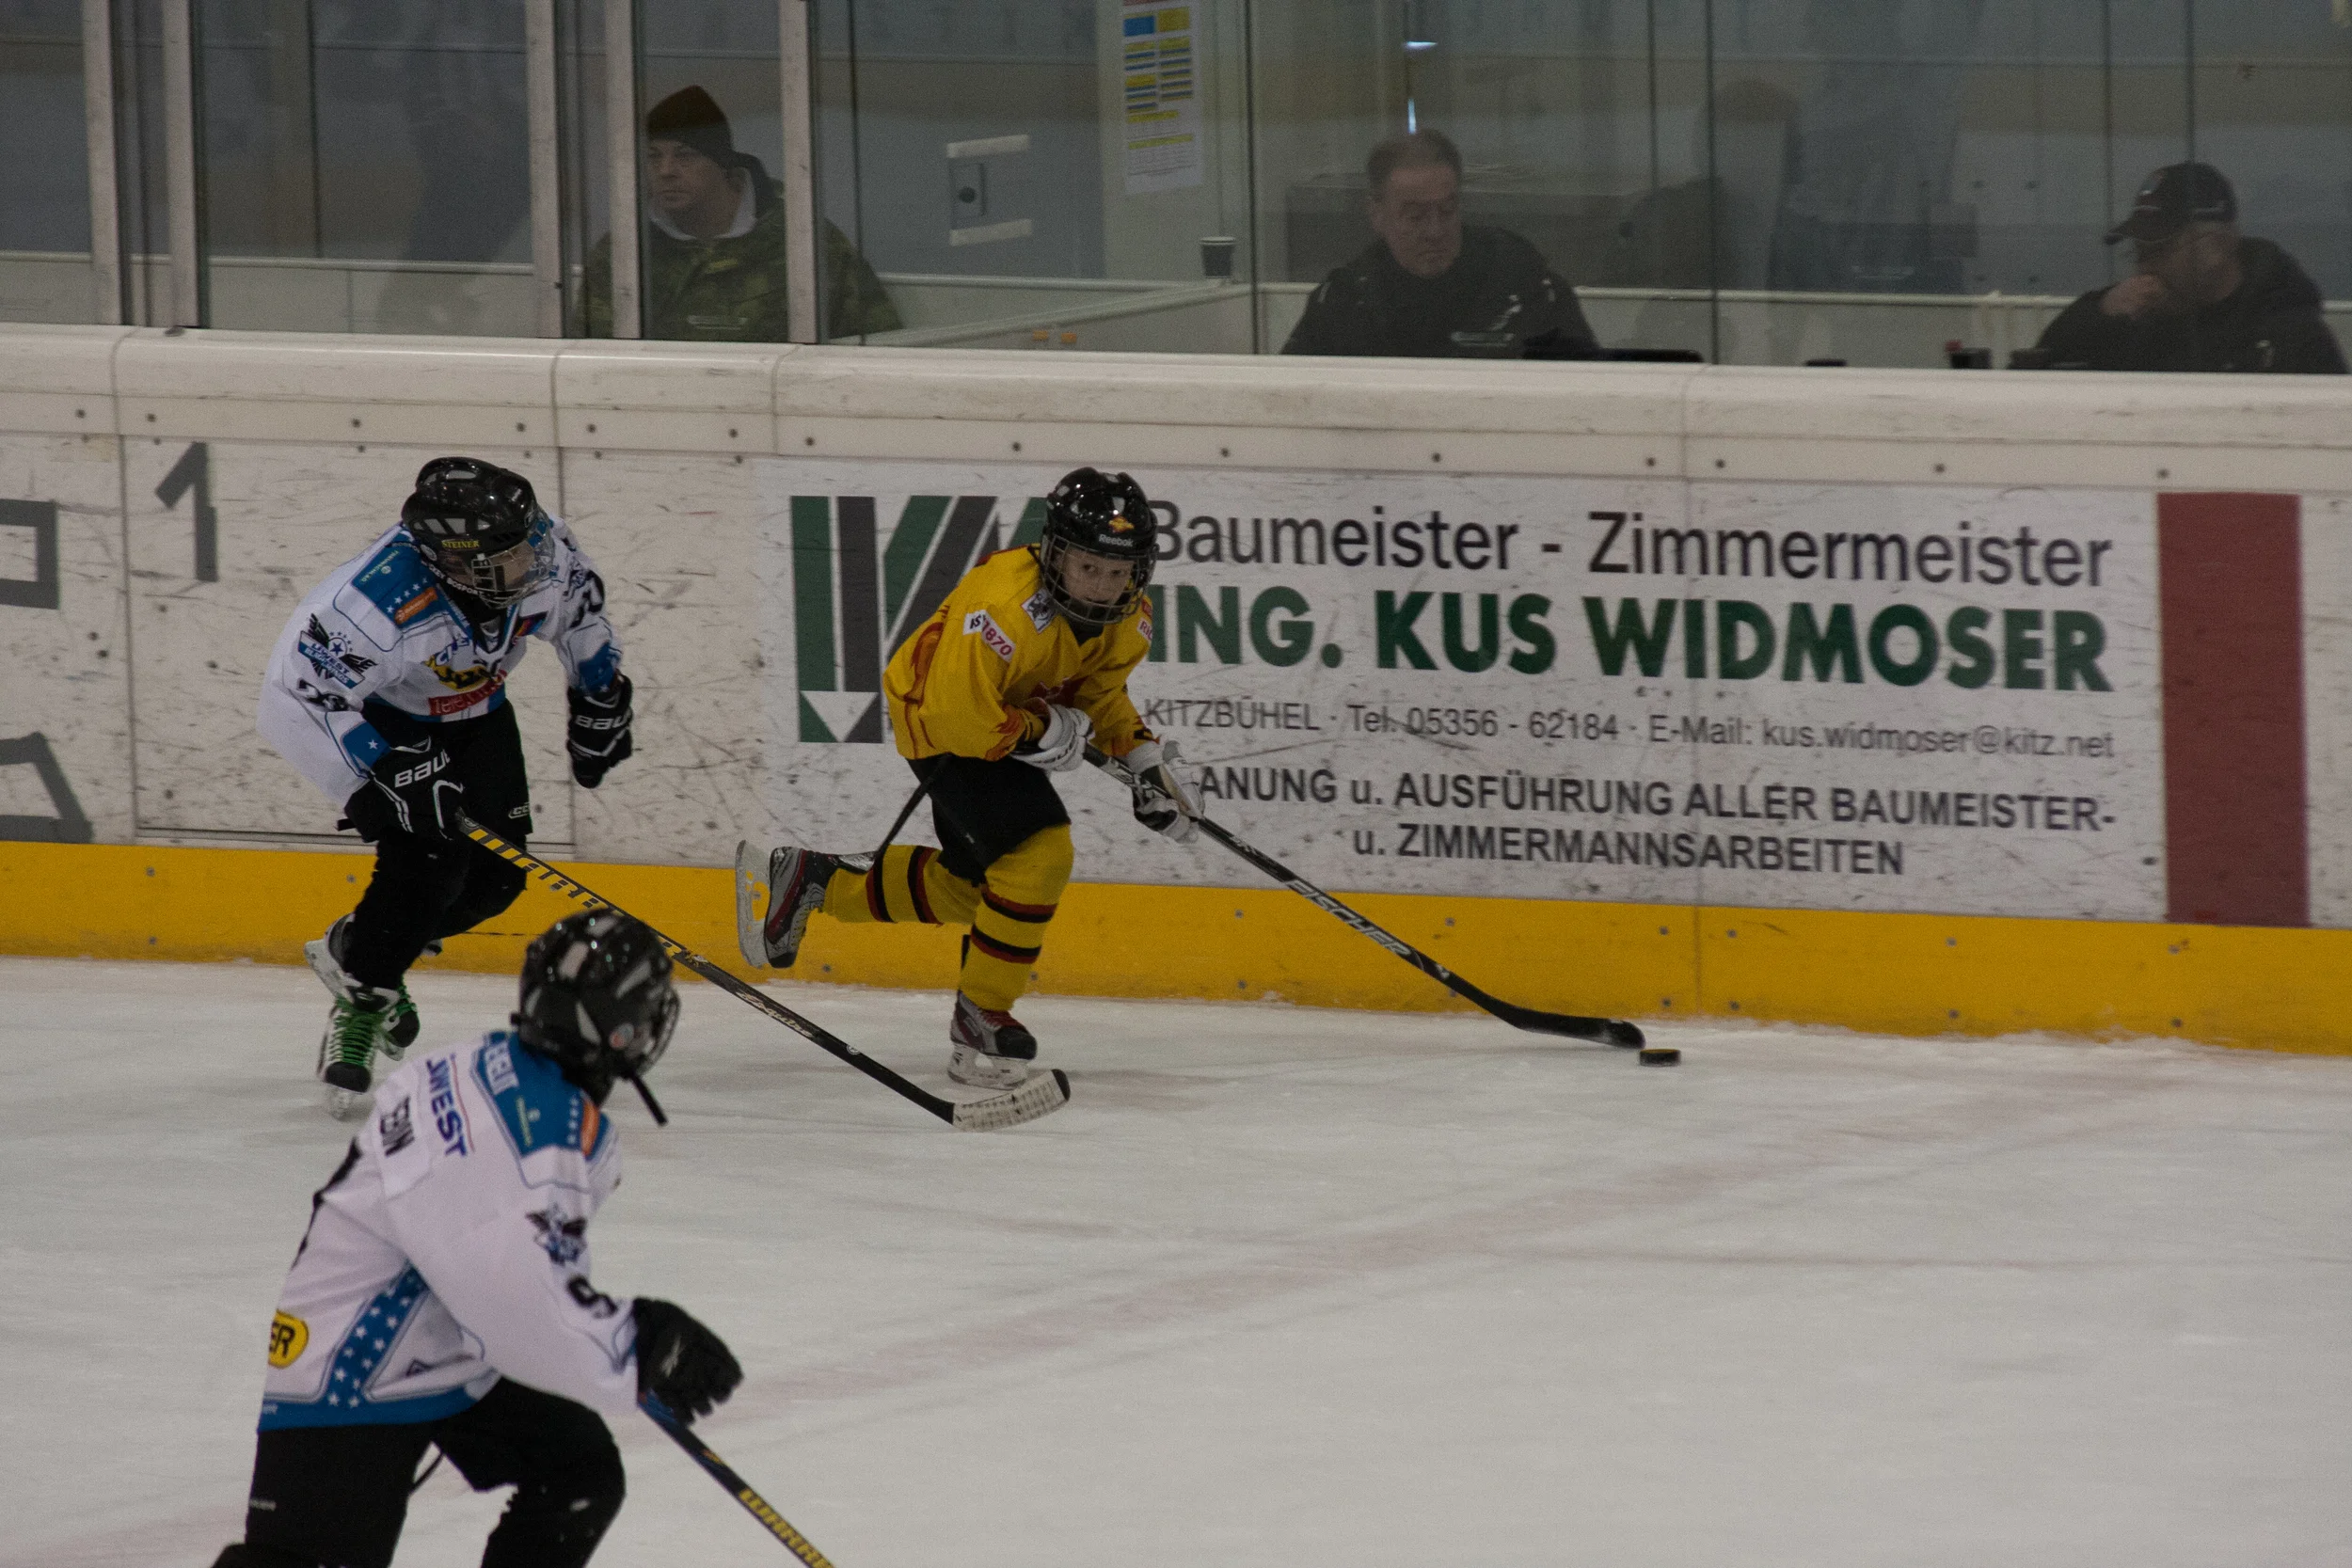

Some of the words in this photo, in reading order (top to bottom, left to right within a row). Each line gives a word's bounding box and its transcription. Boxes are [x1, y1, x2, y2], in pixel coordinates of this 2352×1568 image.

[1099, 533, 1134, 547] Reebok
[1152, 499, 1519, 570] Baumeister
[1588, 511, 2113, 587] Zimmermeister
[1148, 584, 1343, 669] ING.
[1375, 590, 1558, 675] KUS
[1581, 595, 2114, 692] WIDMOSER
[1144, 695, 1321, 732] KITZBÜHEL
[1408, 707, 1500, 737] 05356
[1528, 709, 1620, 741] 62184
[1649, 714, 1754, 746] E-Mail:
[1763, 720, 2115, 758] kus.widmoser@kitz.net
[1198, 766, 1337, 803] ANUNG
[1351, 780, 1383, 805] u.
[1393, 769, 1673, 816] AUSFÜHRUNG
[1683, 783, 1818, 823] ALLER
[1830, 787, 2116, 832] BAUMEISTER-
[1354, 830, 1386, 855] u.
[1396, 822, 1905, 876] ZIMMERMANNSARBEITEN
[468, 828, 682, 958] WARRR
